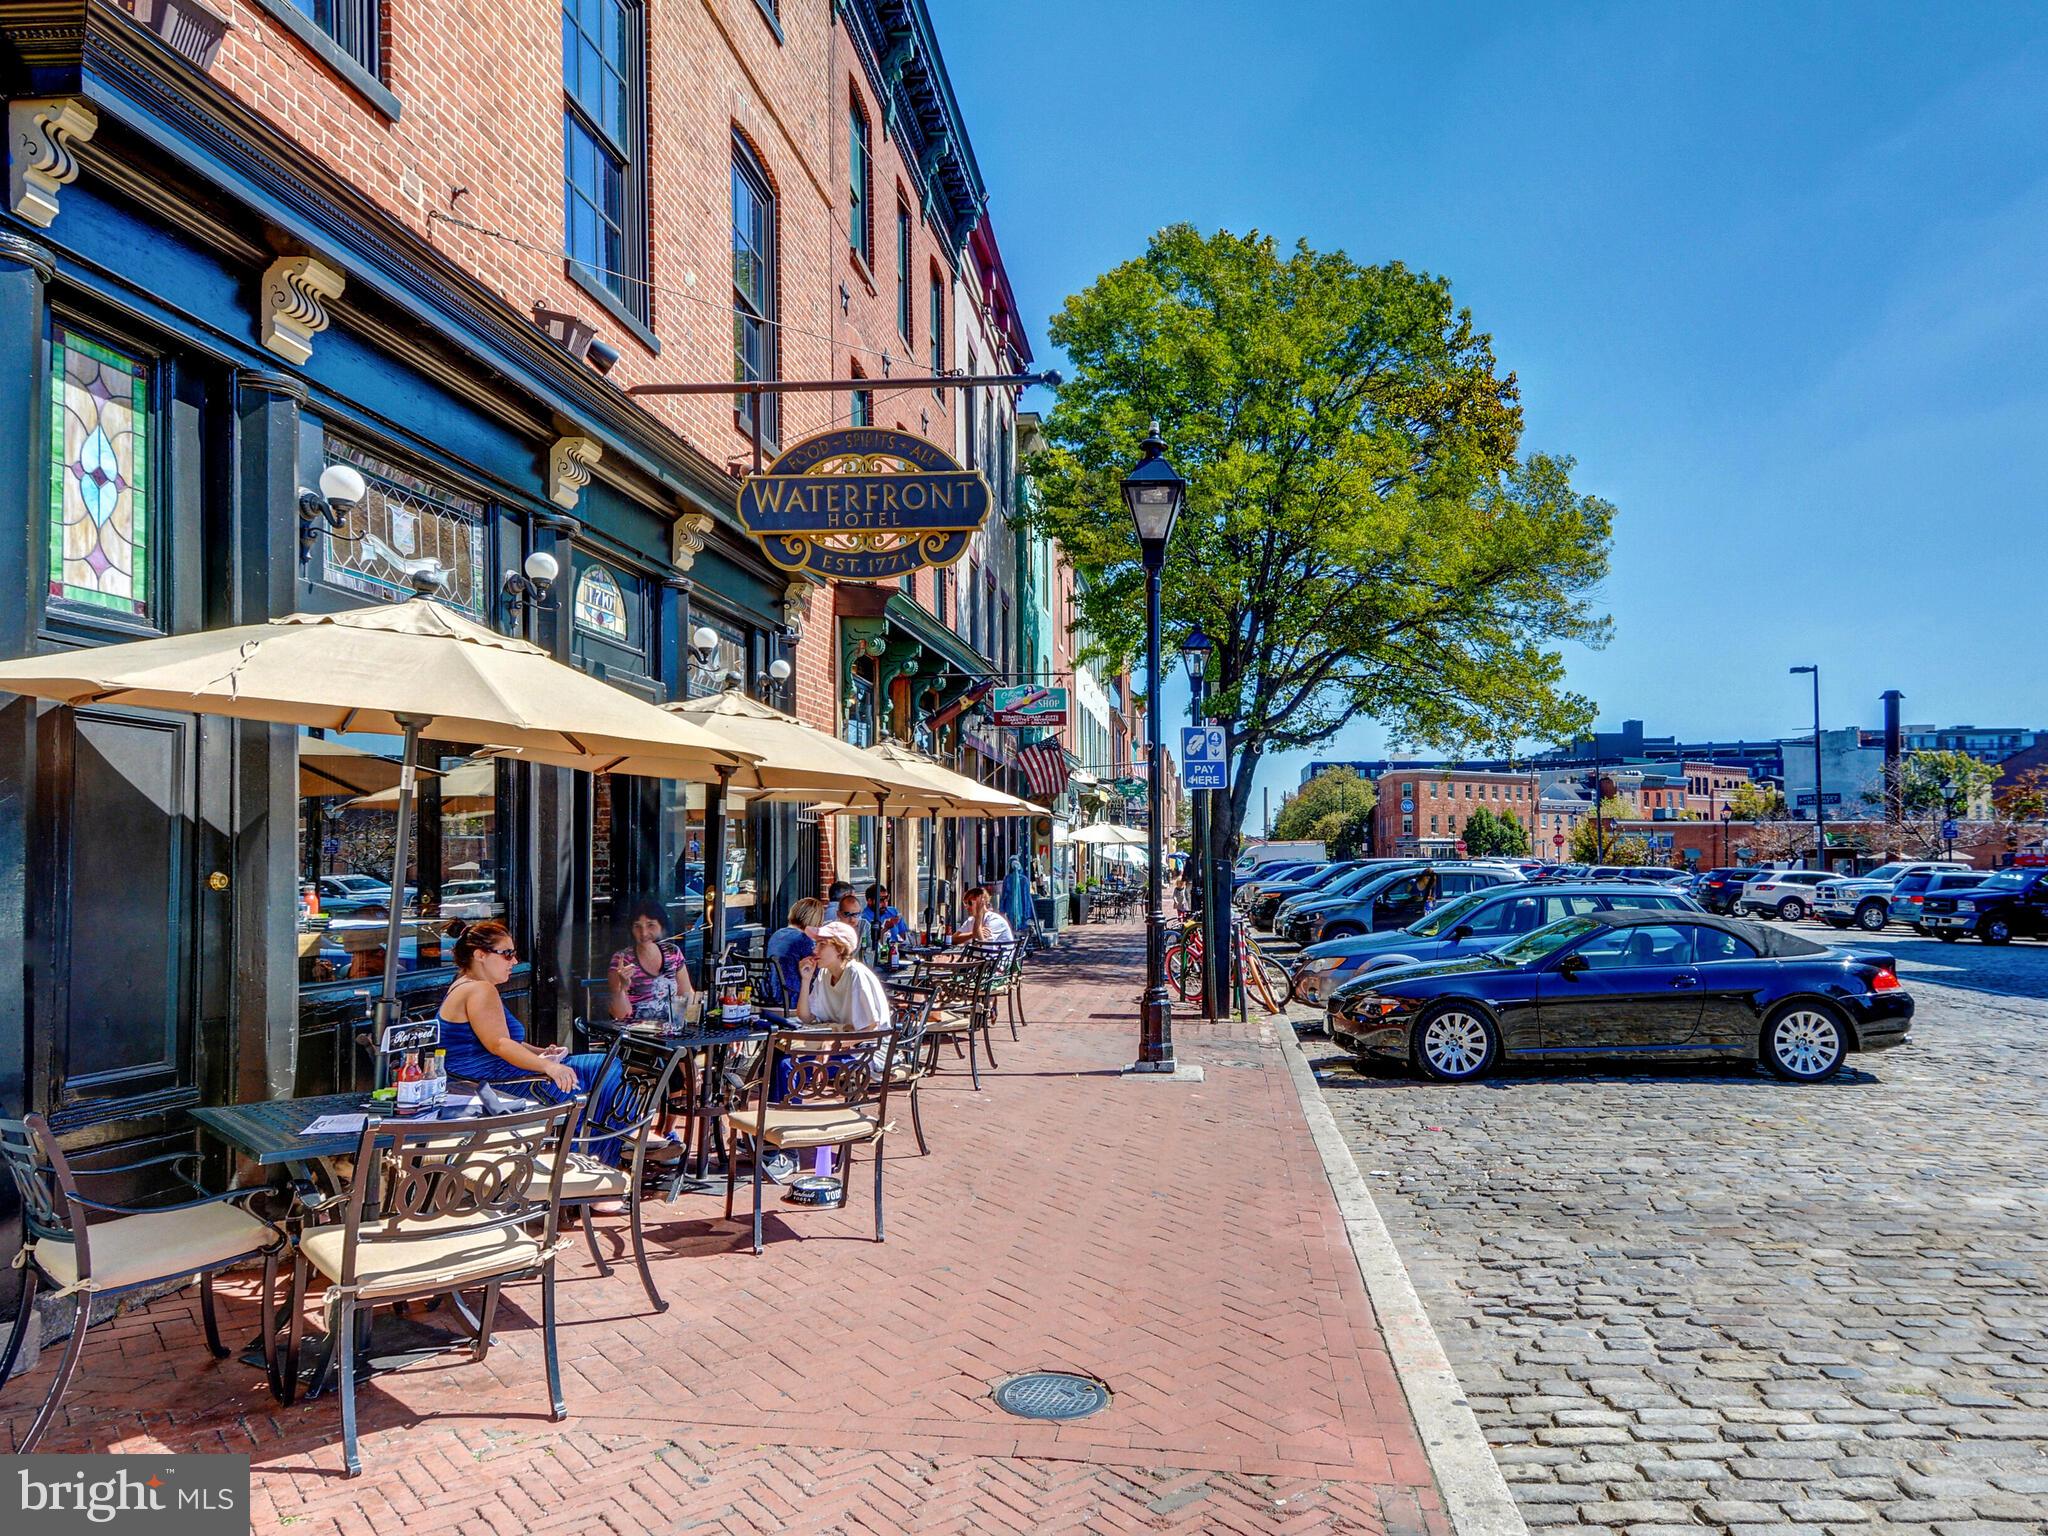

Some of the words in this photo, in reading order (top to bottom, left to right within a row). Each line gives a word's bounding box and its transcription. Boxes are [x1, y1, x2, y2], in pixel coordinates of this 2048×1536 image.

[787, 441, 828, 470] FOOD
[845, 432, 896, 450] SPIRITS
[752, 480, 975, 514] WATERFRONT
[827, 512, 902, 528] HOTEL
[822, 554, 860, 573] EST.
[868, 552, 910, 573] 1771
[1038, 699, 1060, 708] SHOP
[1211, 732, 1219, 742] 4
[1194, 765, 1215, 774] PAY
[1192, 775, 1220, 785] HERE
[393, 1025, 435, 1043] Resved
